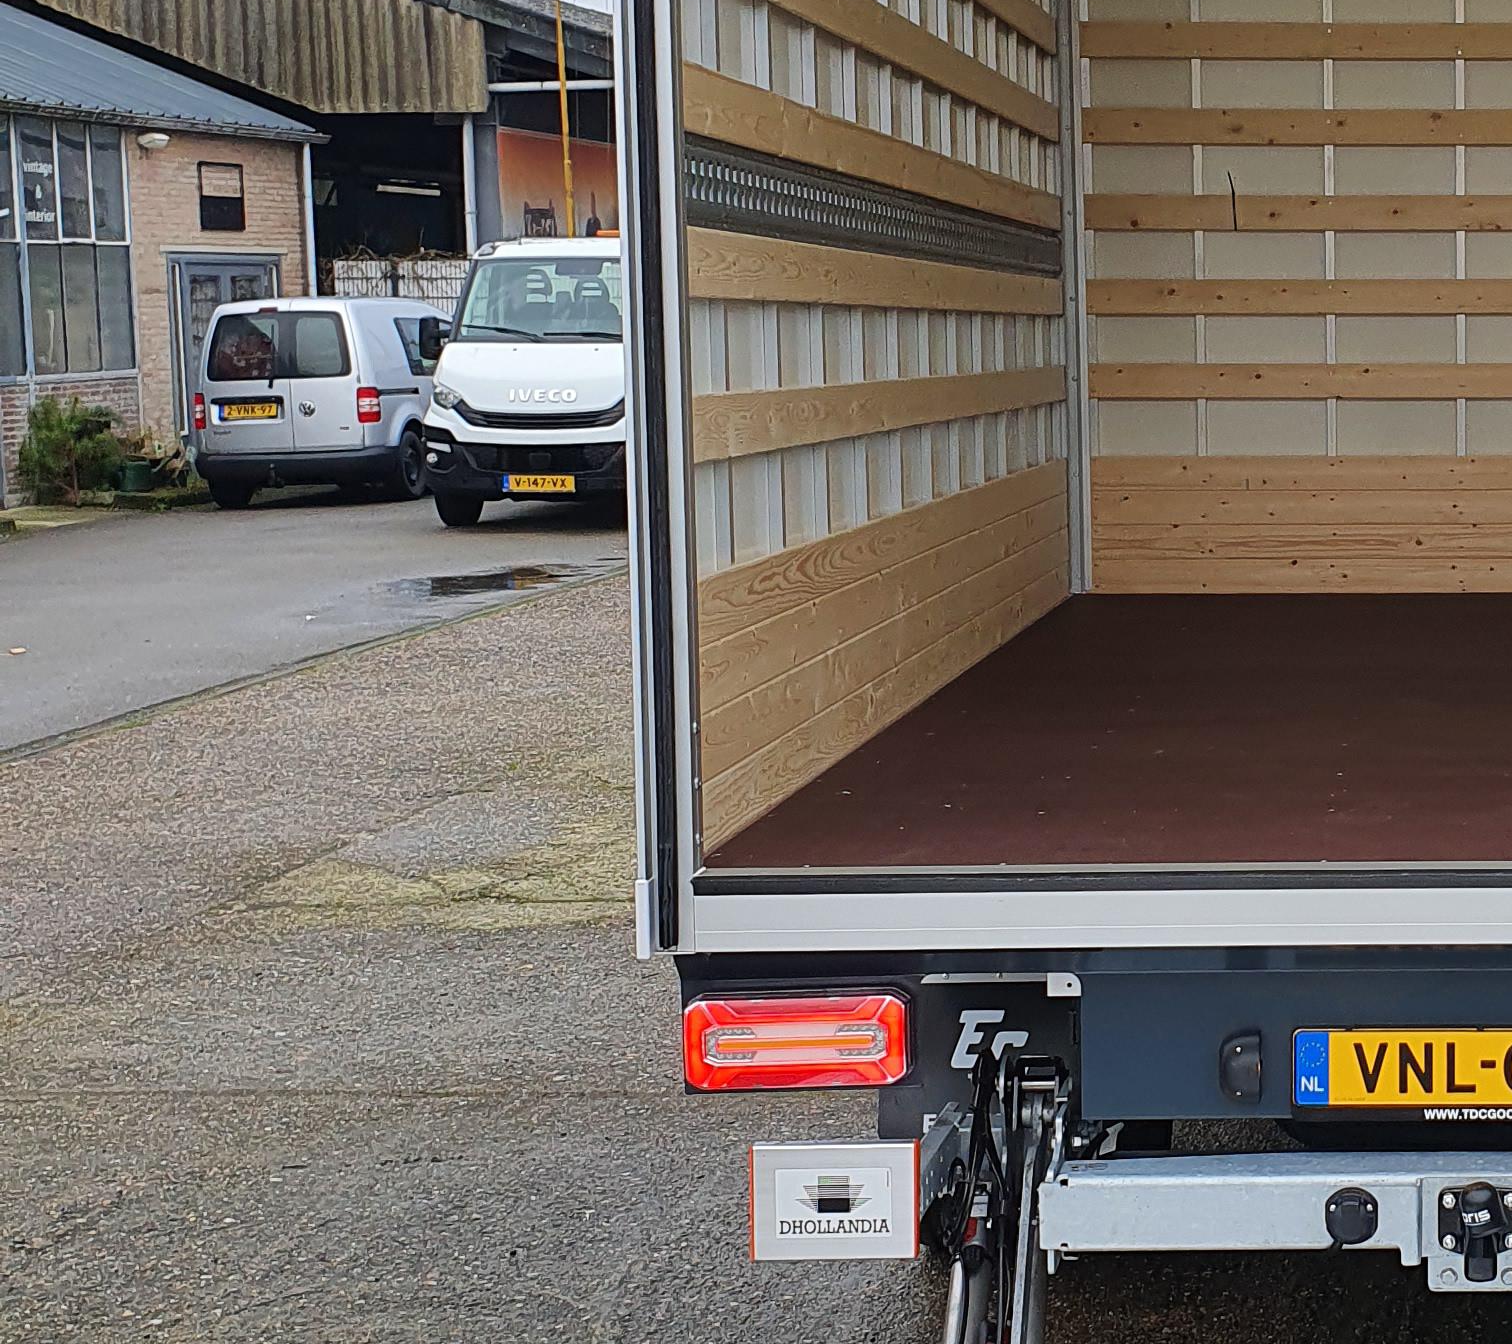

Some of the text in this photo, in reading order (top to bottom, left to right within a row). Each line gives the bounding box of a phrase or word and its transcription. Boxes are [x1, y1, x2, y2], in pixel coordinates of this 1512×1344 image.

[23, 159, 52, 177] vintage
[509, 388, 577, 403] IVECO
[227, 405, 273, 417] 2-VNK-97
[514, 477, 567, 488] V-147-VX
[1301, 1077, 1324, 1092] NL
[779, 1219, 890, 1234] DHOLLANDIA
